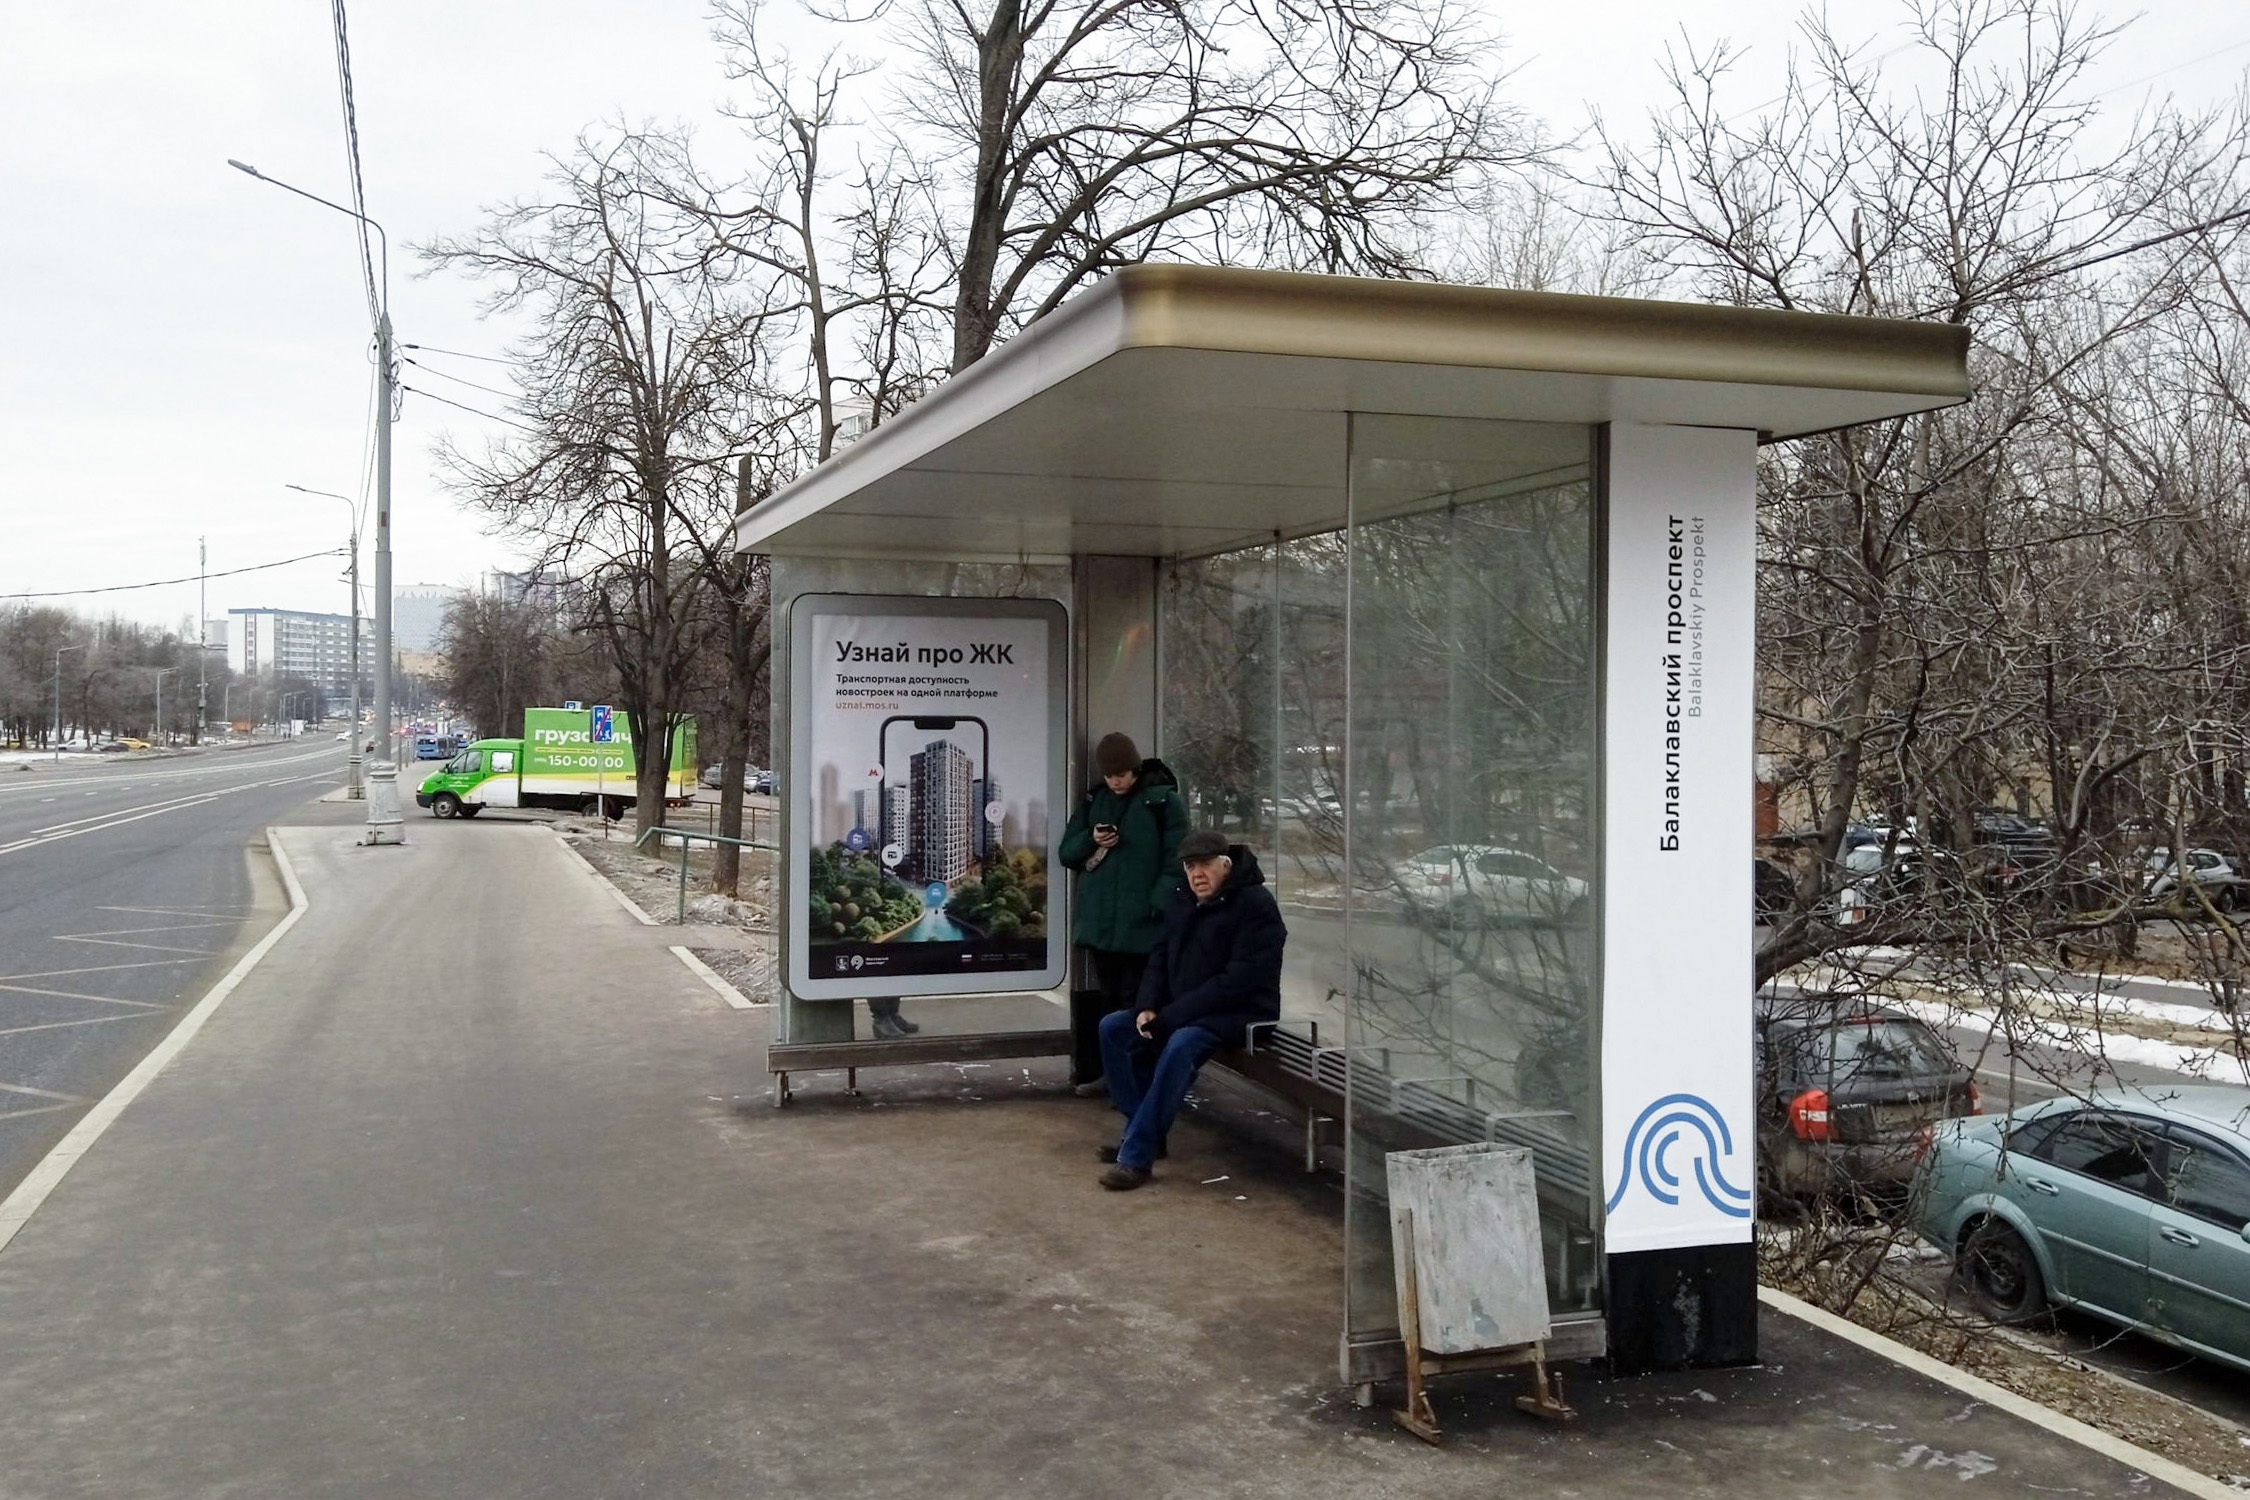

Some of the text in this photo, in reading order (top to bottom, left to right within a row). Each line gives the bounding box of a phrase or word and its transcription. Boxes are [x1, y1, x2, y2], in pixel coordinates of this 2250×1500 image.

[1688, 515, 1707, 718] Balaklavskiy Prospekt
[836, 641, 1014, 668] Узнай про ЖК
[836, 674, 970, 686] Транспортная доступность
[1660, 514, 1687, 852] Балаклавский проспект
[836, 687, 998, 699] новостроек на одной платформе
[548, 755, 624, 768] 150-0000
